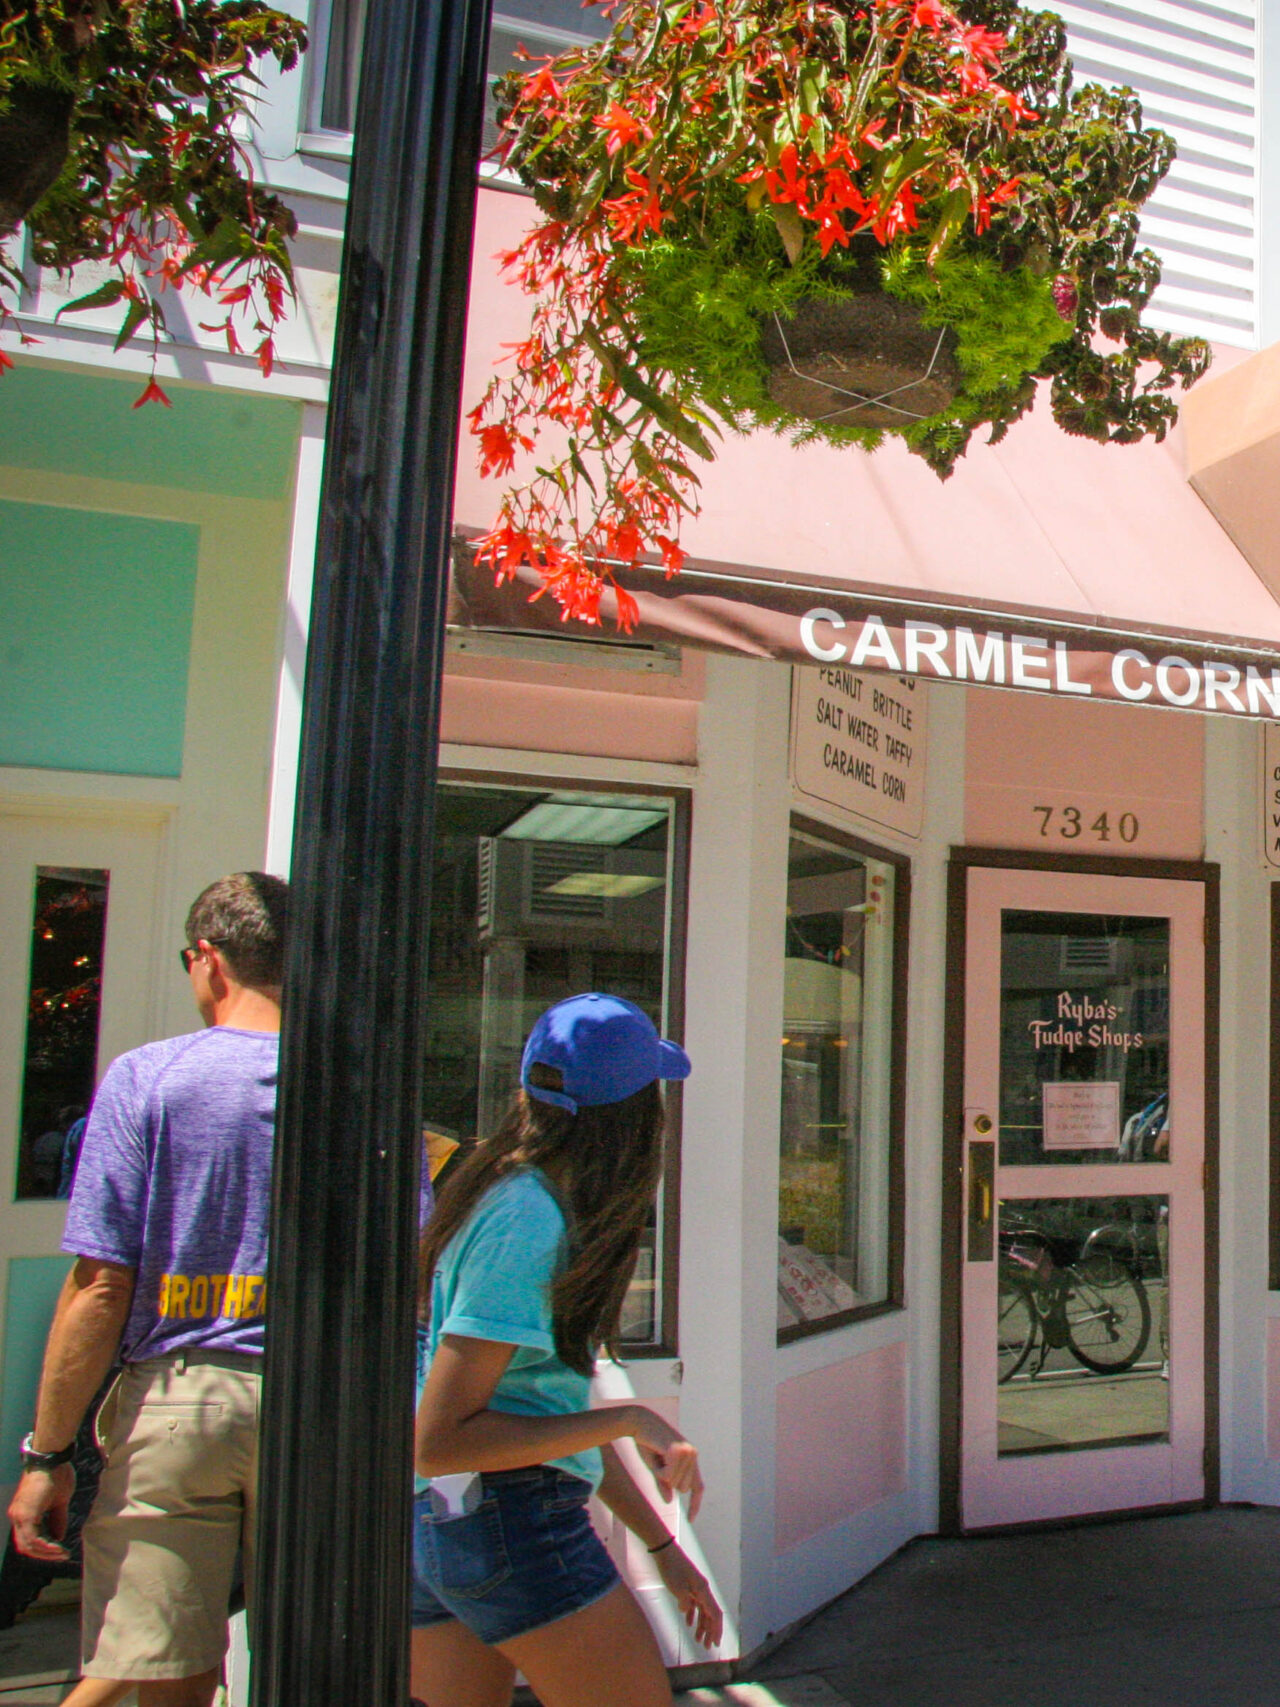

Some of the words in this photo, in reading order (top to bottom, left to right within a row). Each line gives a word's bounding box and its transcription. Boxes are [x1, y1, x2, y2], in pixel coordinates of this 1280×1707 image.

[800, 607, 1092, 694] CARMEL
[873, 688, 912, 731] BRITTLE
[816, 697, 844, 731] SALT
[847, 713, 878, 751] WATER
[885, 734, 913, 768] TAFFY
[823, 743, 877, 789] CARAMEL
[882, 772, 906, 803] CORN
[1033, 806, 1139, 843] 7340
[1057, 991, 1118, 1027] Ryba's
[1028, 1020, 1083, 1053] Fudge
[1088, 1024, 1143, 1053] Shops
[158, 1273, 267, 1318] BROTHE
